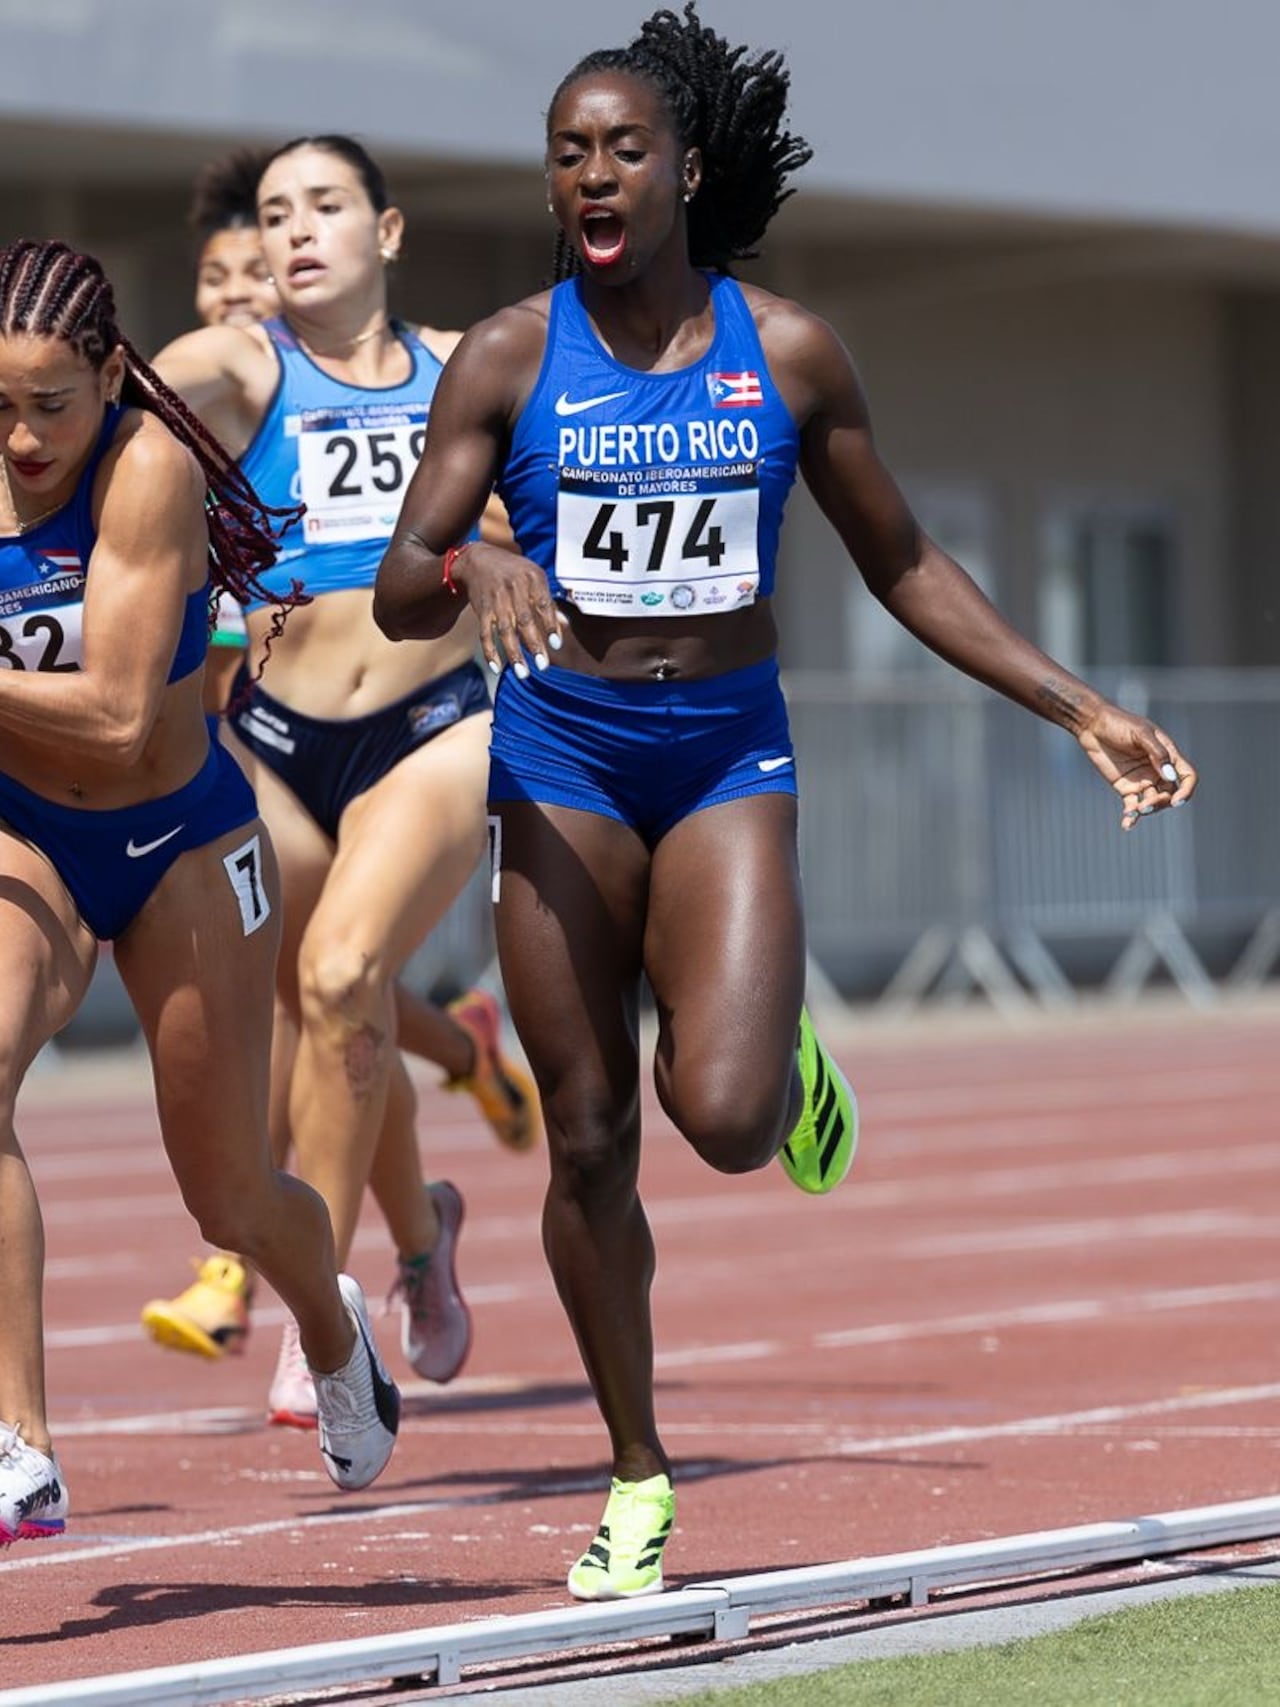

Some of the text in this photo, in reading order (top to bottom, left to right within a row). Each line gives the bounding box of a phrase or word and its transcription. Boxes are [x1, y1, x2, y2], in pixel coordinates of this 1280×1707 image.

[558, 418, 759, 466] PUERTO RICO
[561, 462, 754, 483] CAMPEONATO IBEROAMERICANO
[618, 480, 697, 496] DE MAYORES
[582, 498, 726, 574] 474
[235, 848, 262, 921] 7
